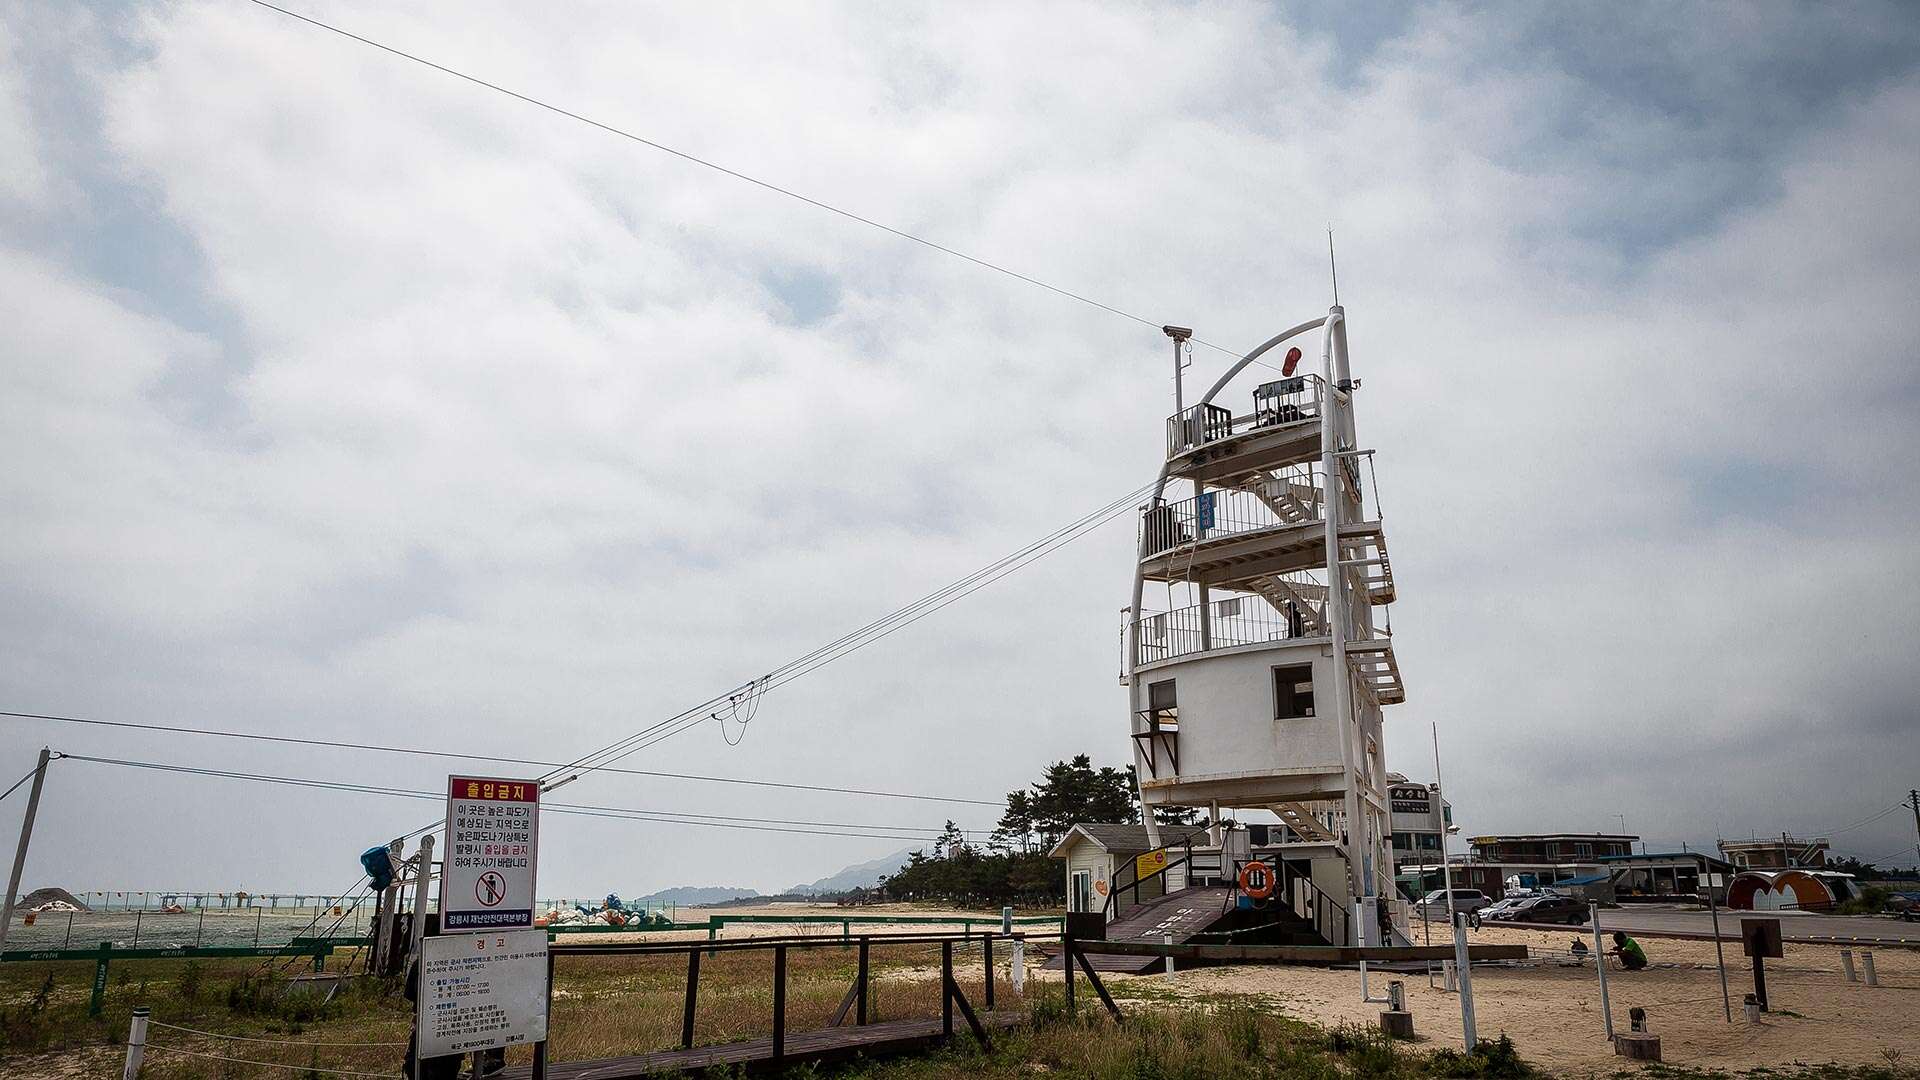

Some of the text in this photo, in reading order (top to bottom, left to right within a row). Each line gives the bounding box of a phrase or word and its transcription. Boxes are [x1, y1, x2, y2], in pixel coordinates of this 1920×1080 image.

[467, 782, 524, 800] 출입금지
[458, 805, 530, 817] 이 곳은 높은 파도가
[457, 818, 529, 830] 예상되는 지역으로
[498, 832, 529, 843] 기상특보
[456, 844, 528, 856] 발령시 출입을 금지
[455, 857, 528, 868] 하여 주시기 바랍니다
[449, 914, 470, 925] 강릉시
